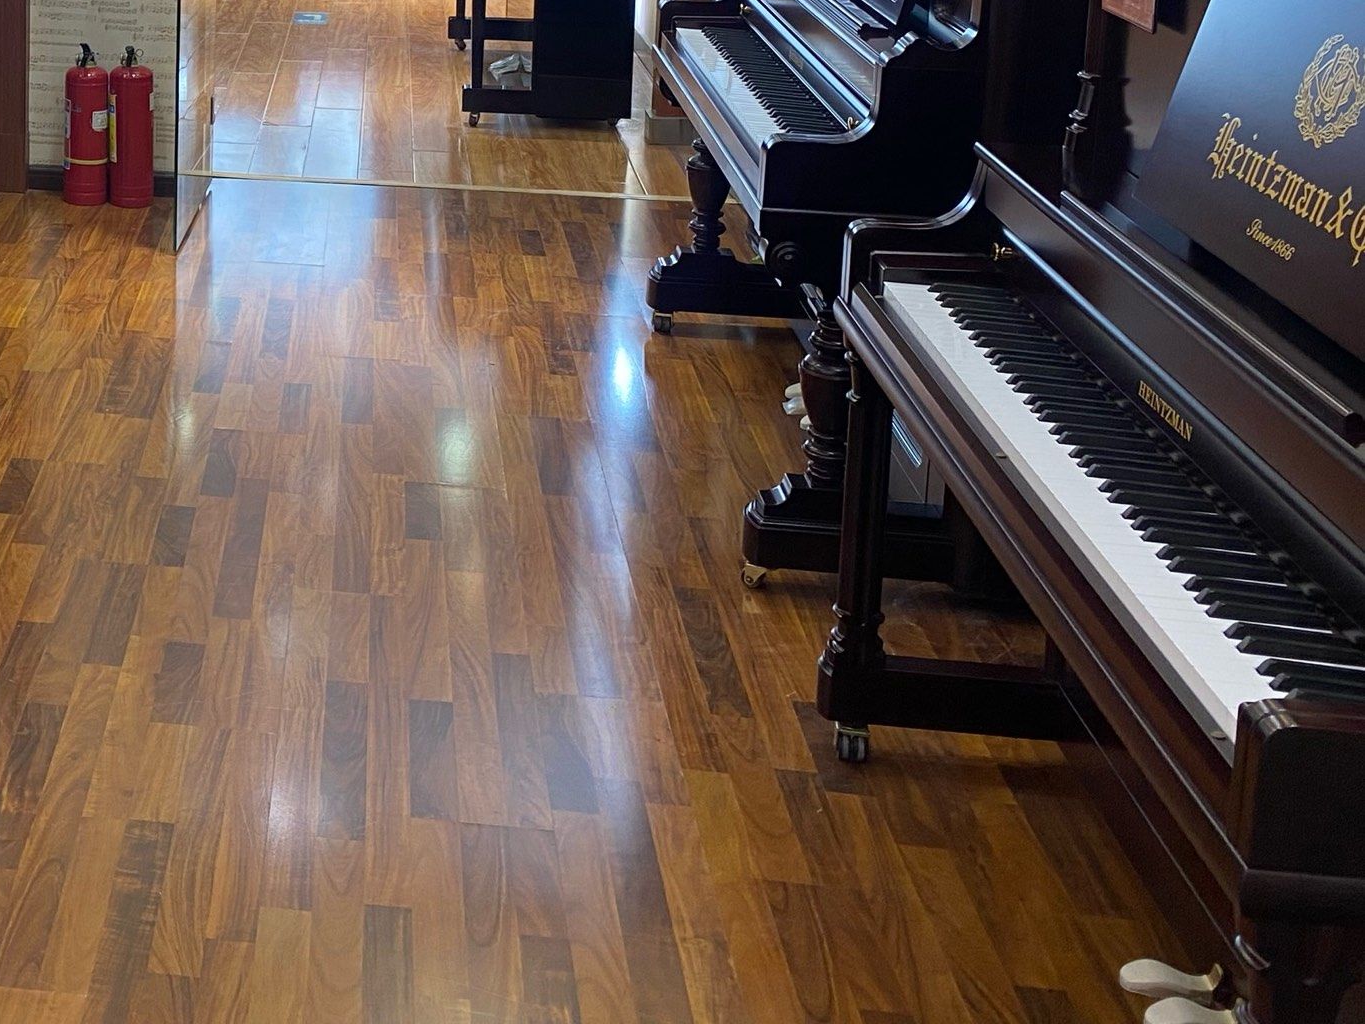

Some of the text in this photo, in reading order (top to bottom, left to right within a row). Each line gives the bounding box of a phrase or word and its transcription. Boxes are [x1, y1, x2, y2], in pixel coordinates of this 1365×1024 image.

[1207, 112, 1332, 227] Heintzman
[1324, 185, 1354, 239] &
[1138, 380, 1193, 442] HEINTZMAN
